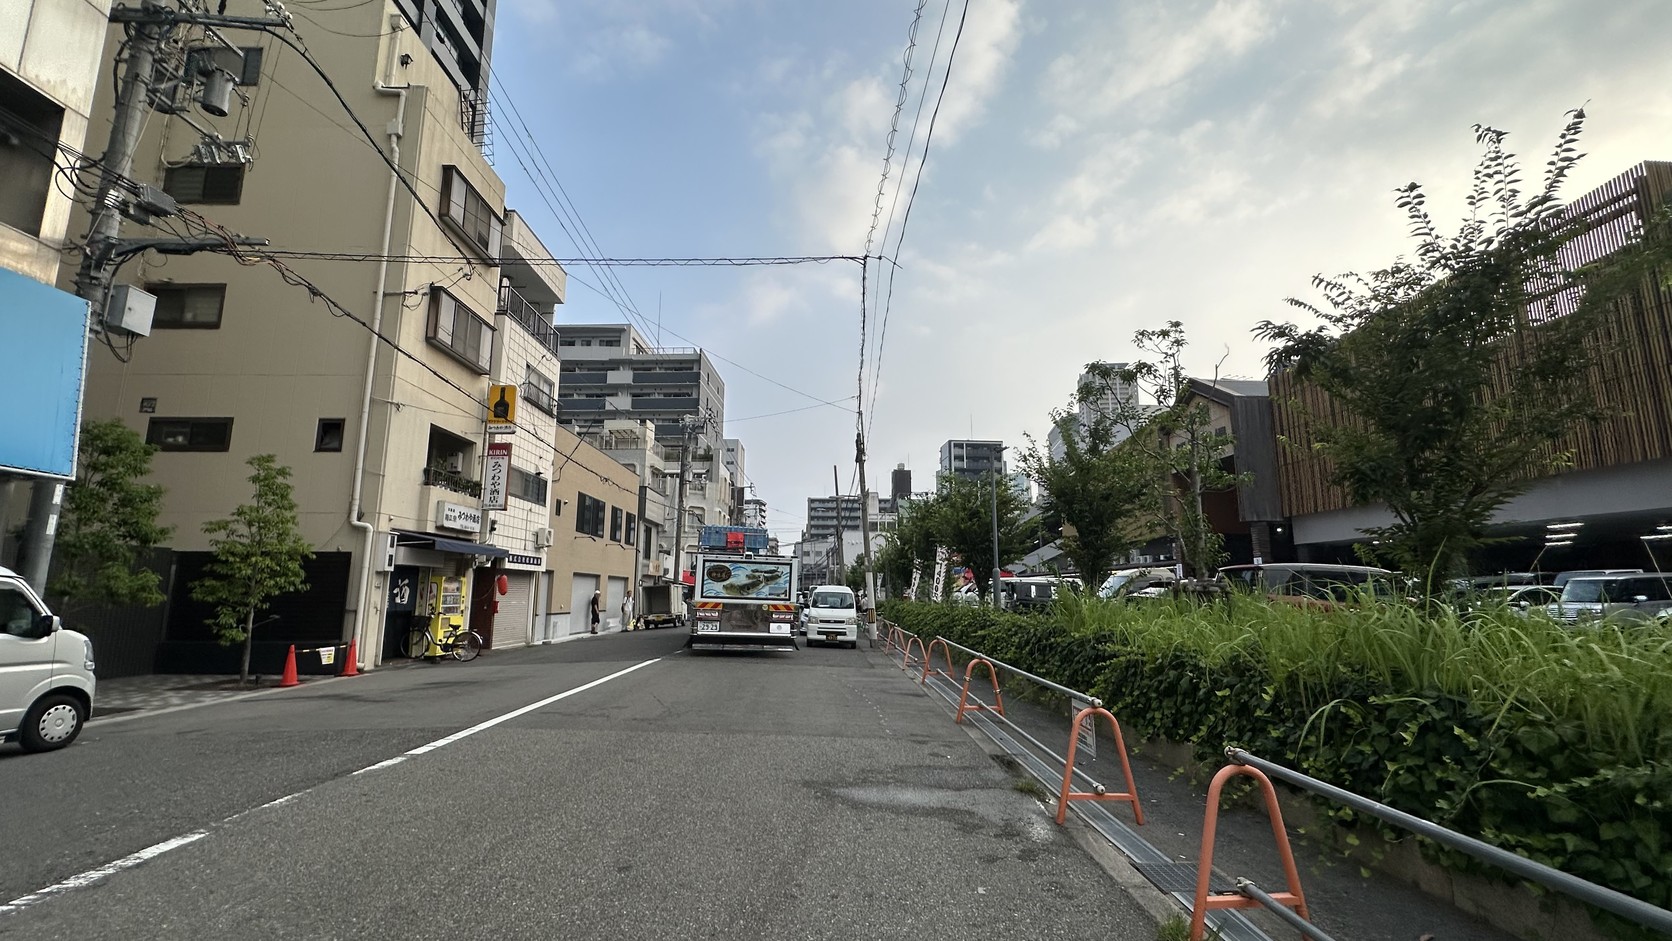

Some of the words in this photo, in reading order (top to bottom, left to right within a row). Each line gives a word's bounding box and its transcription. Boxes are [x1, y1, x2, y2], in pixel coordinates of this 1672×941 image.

[489, 461, 502, 503] みつわや酒店
[393, 578, 410, 605] 酒
